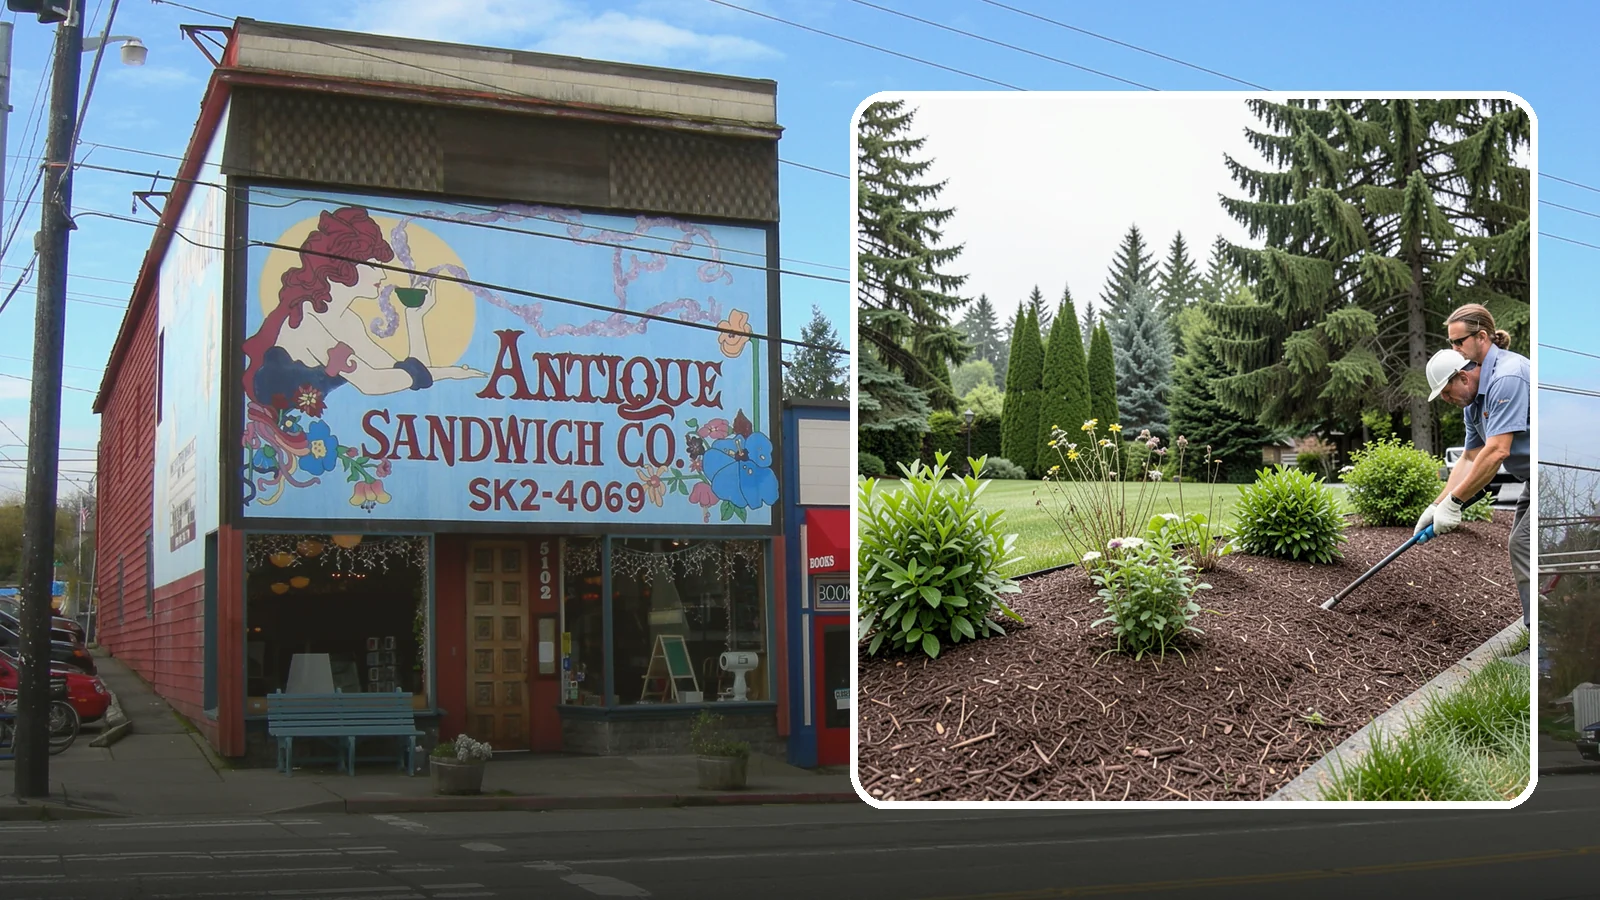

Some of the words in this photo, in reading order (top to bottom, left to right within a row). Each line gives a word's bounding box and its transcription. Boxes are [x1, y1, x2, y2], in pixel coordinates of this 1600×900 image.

[476, 329, 723, 421] ANTIQUE
[361, 408, 604, 467] SANDWICH
[617, 421, 684, 469] CO.
[469, 477, 645, 513] SK2-4069
[540, 541, 552, 600] 5102
[809, 555, 835, 569] BOOKS
